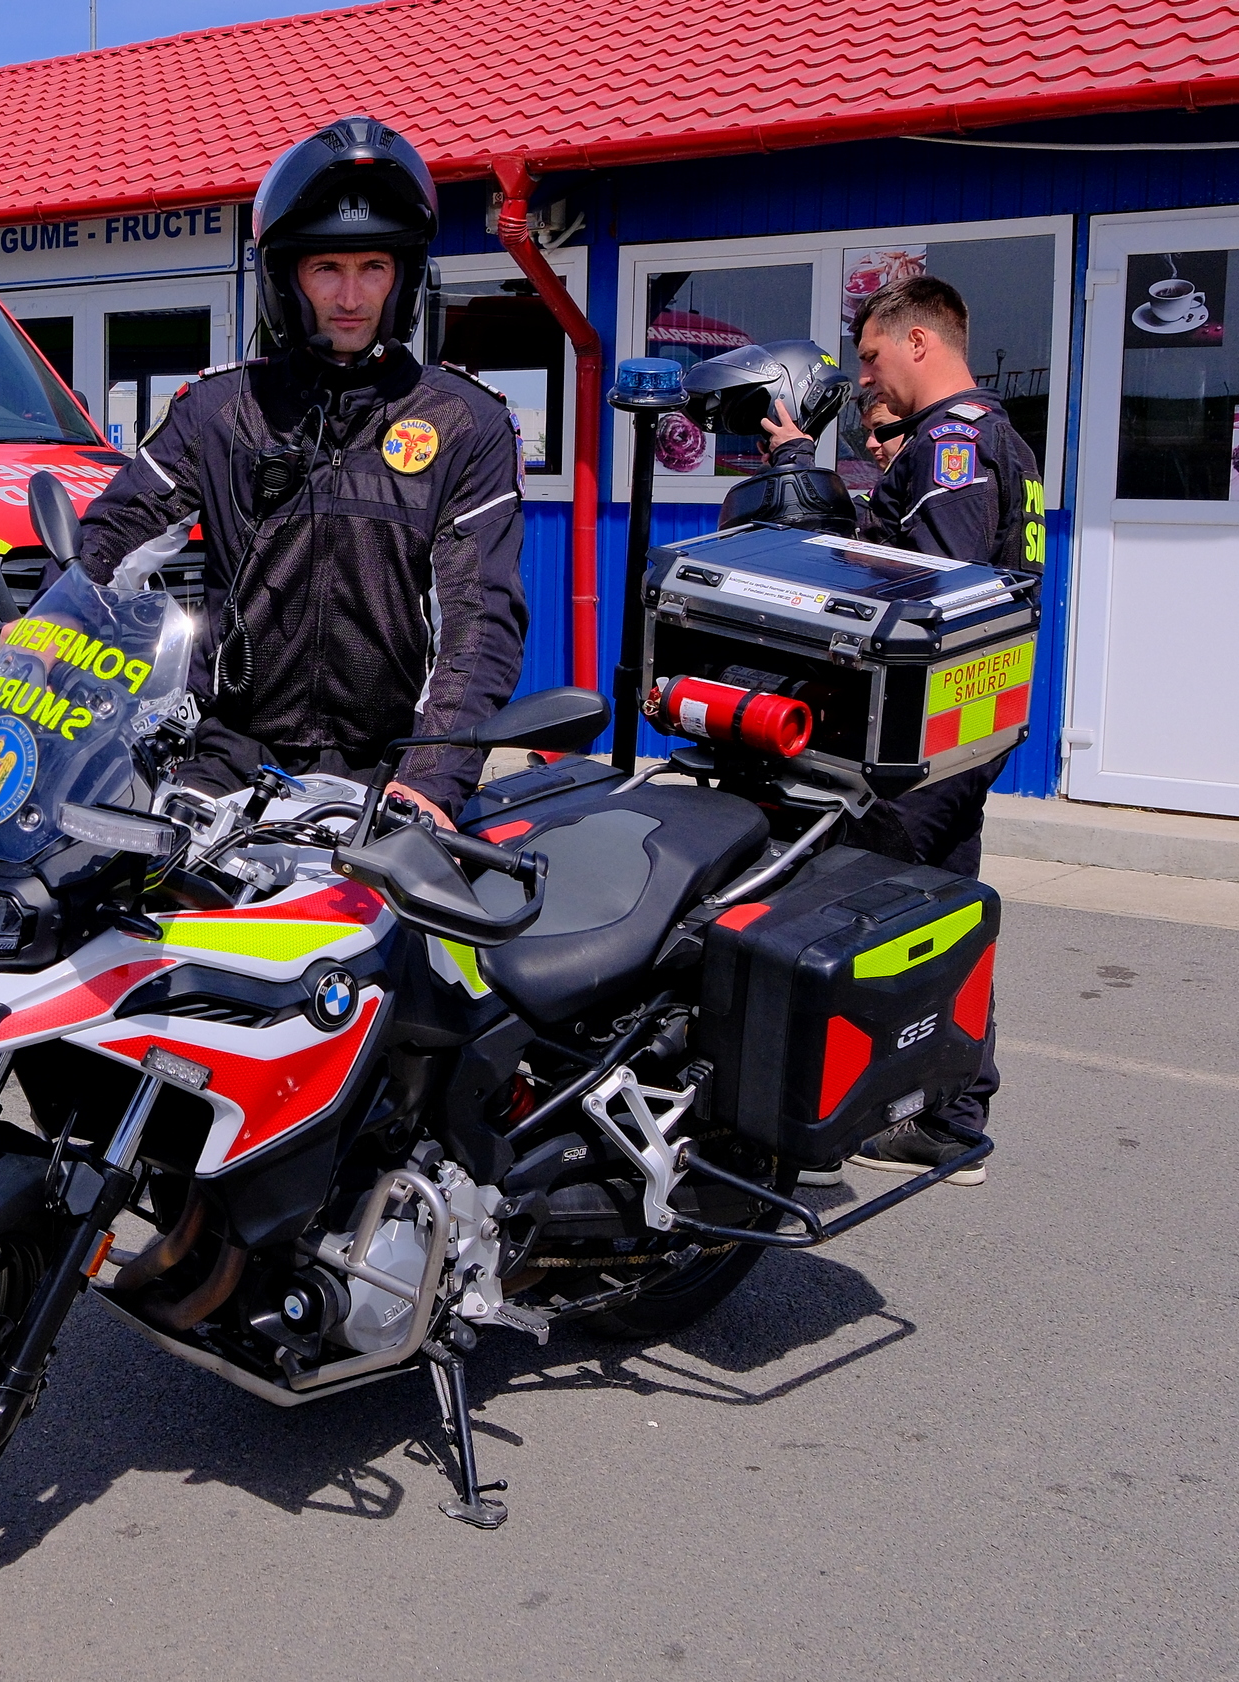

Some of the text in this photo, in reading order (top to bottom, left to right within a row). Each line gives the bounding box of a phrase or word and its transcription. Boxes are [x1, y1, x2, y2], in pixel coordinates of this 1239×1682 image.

[105, 207, 222, 244] FRUCTE
[400, 420, 432, 434] SMURD
[943, 648, 1022, 690] POMPIERII
[954, 672, 1008, 704] SMURD
[896, 1012, 939, 1050] GS
